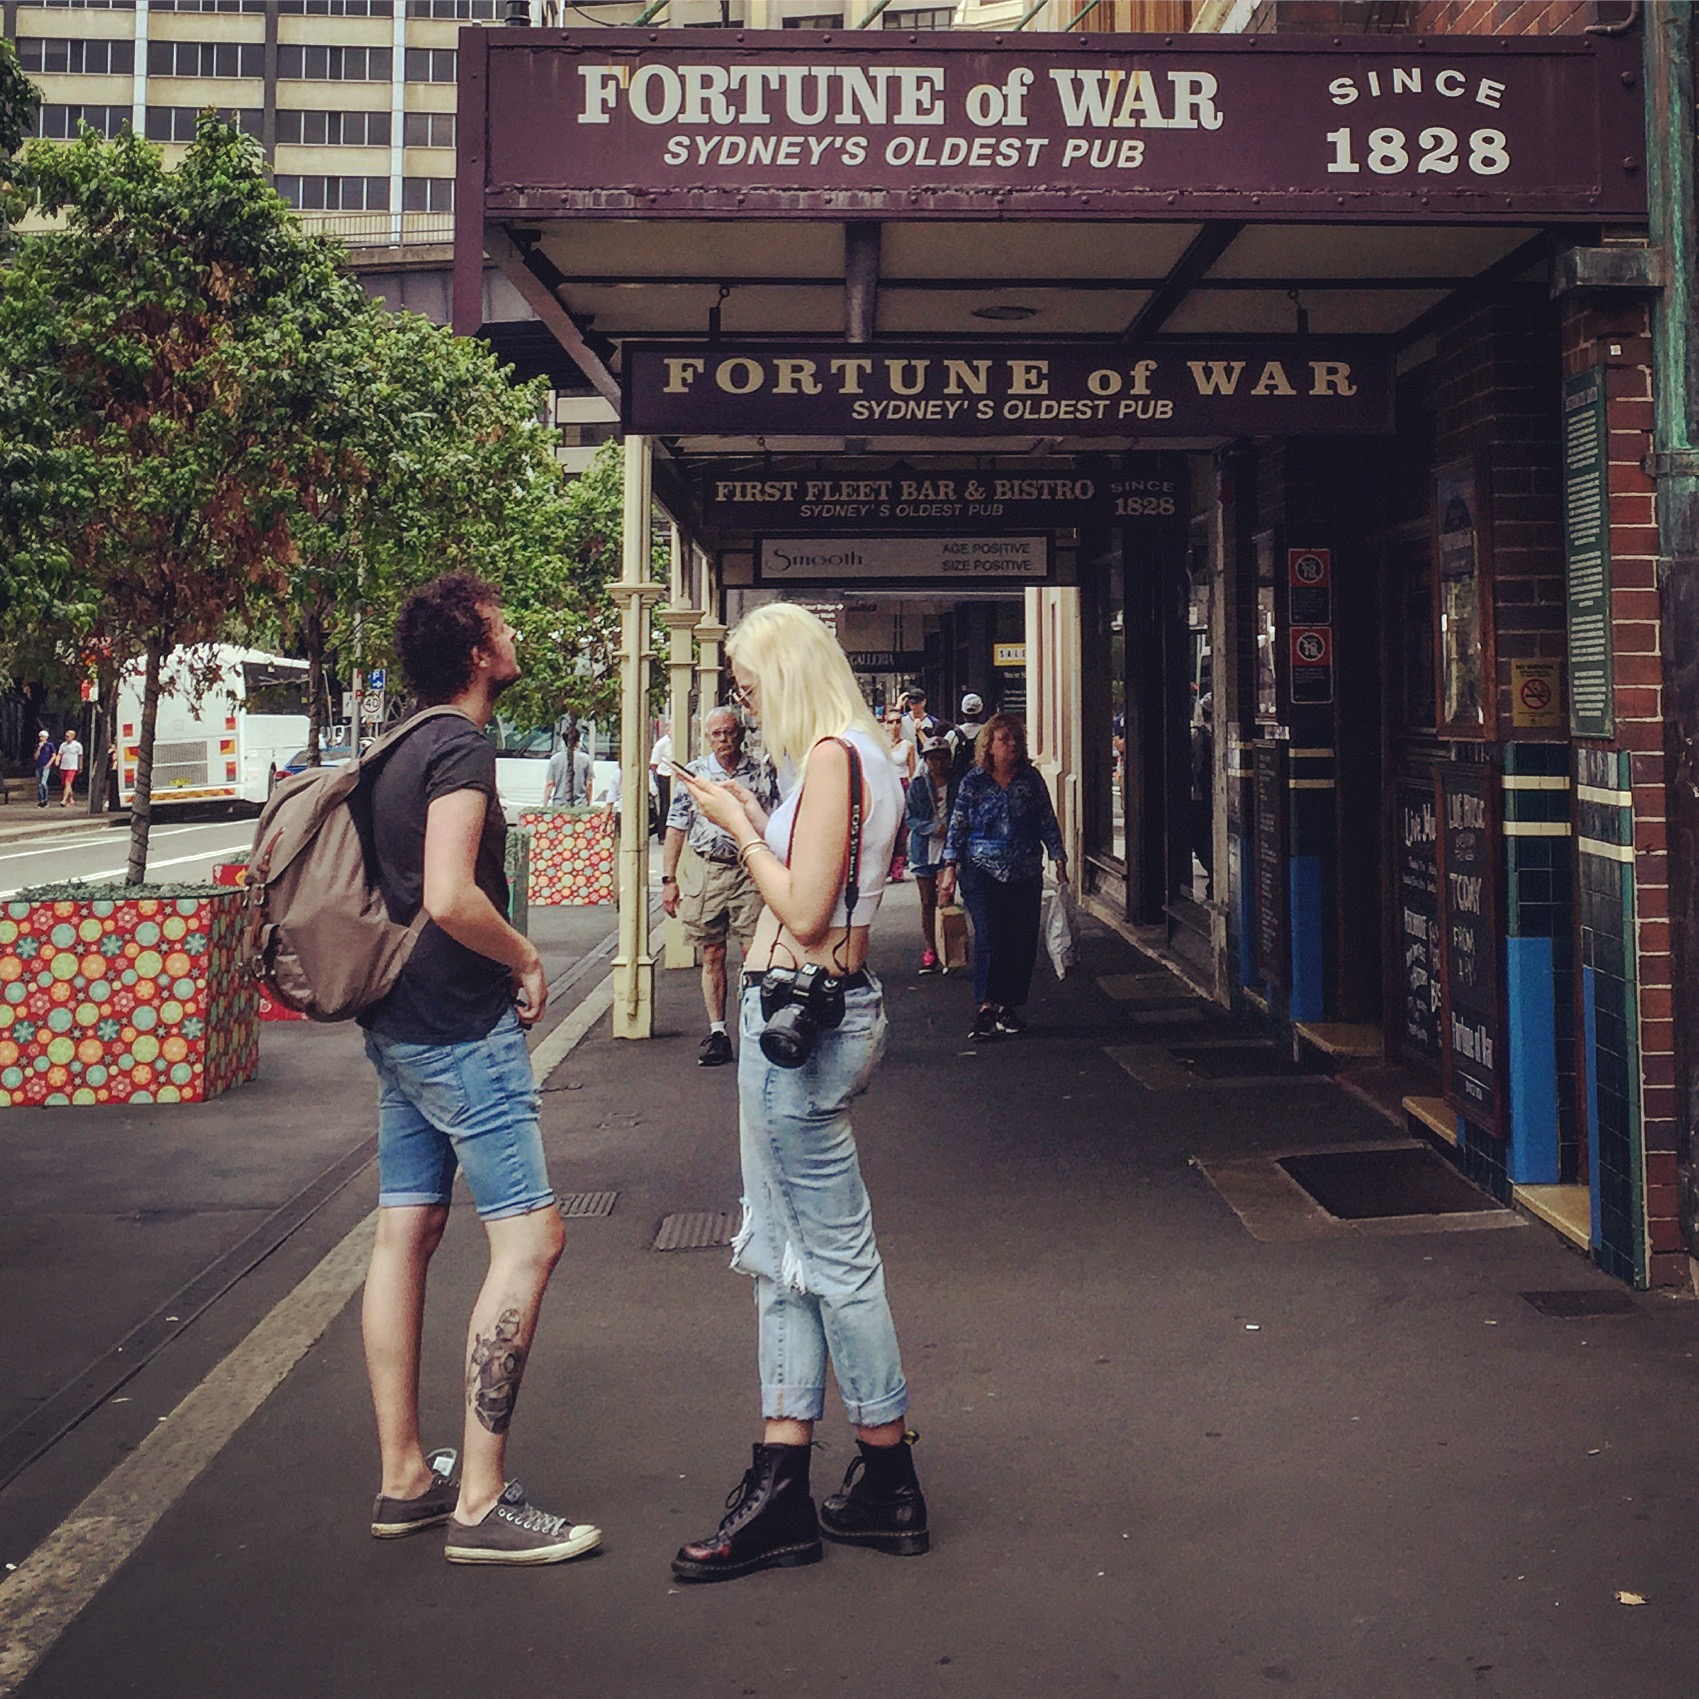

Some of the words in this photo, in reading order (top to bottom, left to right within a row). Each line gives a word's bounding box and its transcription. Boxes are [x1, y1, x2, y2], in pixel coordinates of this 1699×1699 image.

[577, 64, 945, 126] FORTUNE
[966, 67, 1033, 127] of
[1049, 68, 1223, 130] WAR
[1328, 67, 1506, 109] SINCE
[663, 135, 867, 166] SYDNEY'S
[884, 136, 1049, 167] OLDEST
[1061, 138, 1146, 169] PUB
[1326, 127, 1510, 175] 1828
[663, 357, 1051, 396] FORTUNE
[1087, 360, 1157, 396] of
[1188, 360, 1358, 397] WAR
[1003, 399, 1112, 421] OLDEST
[1119, 399, 1174, 421] PUB
[715, 481, 797, 502] FIRST
[805, 480, 892, 501] FLEET
[901, 480, 957, 501] BAR
[964, 480, 986, 500] &
[993, 479, 1095, 500] BISTRO
[1111, 480, 1176, 493] SINCE
[896, 504, 963, 517] OLDEST
[968, 503, 1004, 516] PUB
[1114, 498, 1176, 516] 1828
[942, 543, 970, 555] AGE
[973, 542, 1031, 555] POSITIVE
[766, 549, 864, 572] Smooth
[941, 560, 970, 571] SIZE
[974, 559, 1032, 571] POSITIVE
[365, 698, 379, 708] 40
